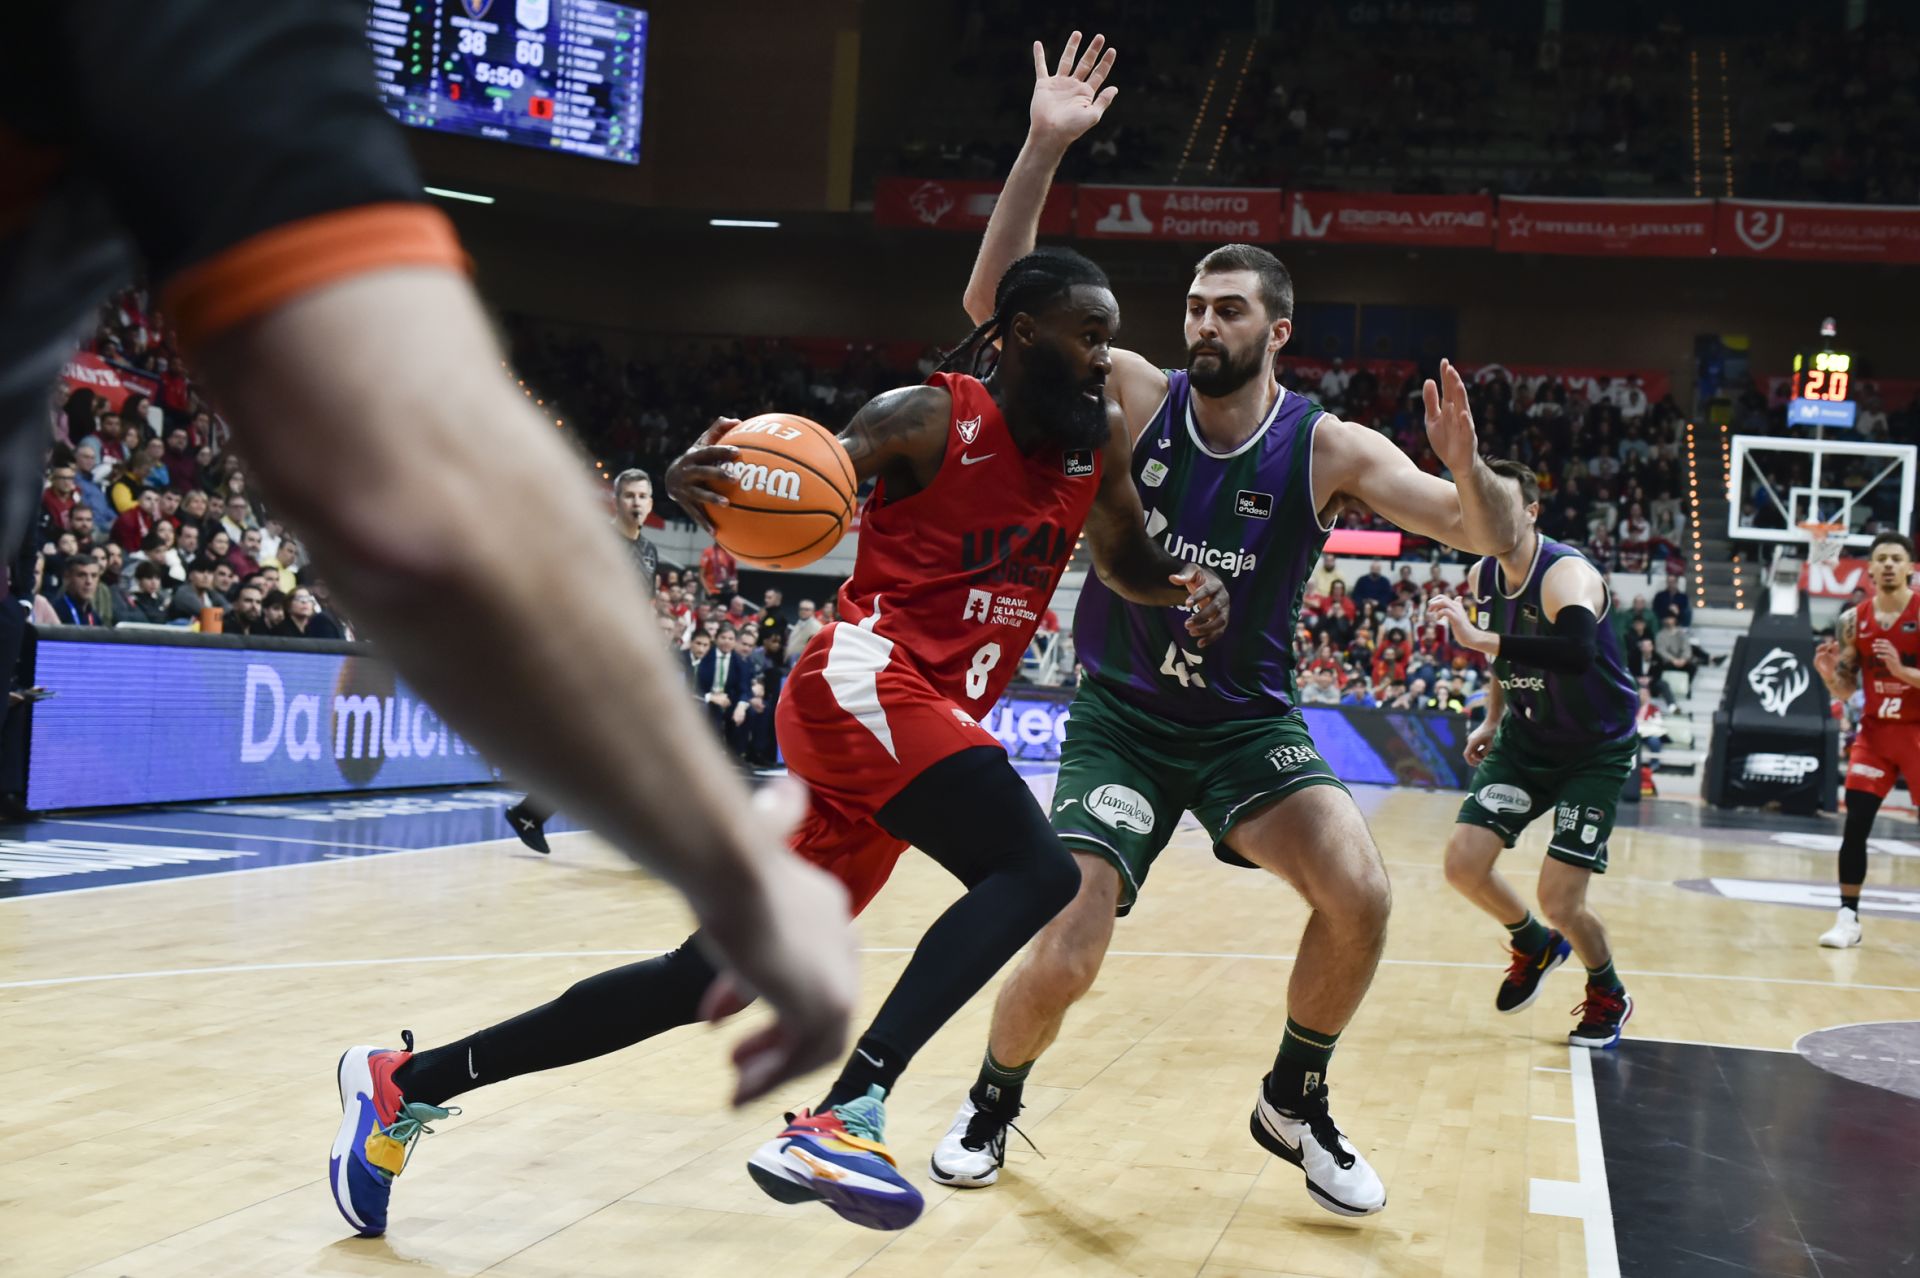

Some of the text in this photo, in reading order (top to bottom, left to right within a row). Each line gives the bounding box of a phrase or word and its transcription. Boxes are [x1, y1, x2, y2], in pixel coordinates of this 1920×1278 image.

[457, 29, 487, 56] 38
[515, 40, 544, 67] 60
[475, 62, 524, 89] 5:50
[1163, 192, 1249, 213] Asterra
[1162, 216, 1260, 237] Partners
[1338, 208, 1486, 227] IBERIA VITAE
[1804, 370, 1848, 401] 2.0
[1164, 533, 1257, 578] Unicaja
[990, 614, 1009, 625] AÑO
[965, 642, 1001, 700] 8
[241, 664, 321, 762] Da
[1878, 697, 1903, 719] 12
